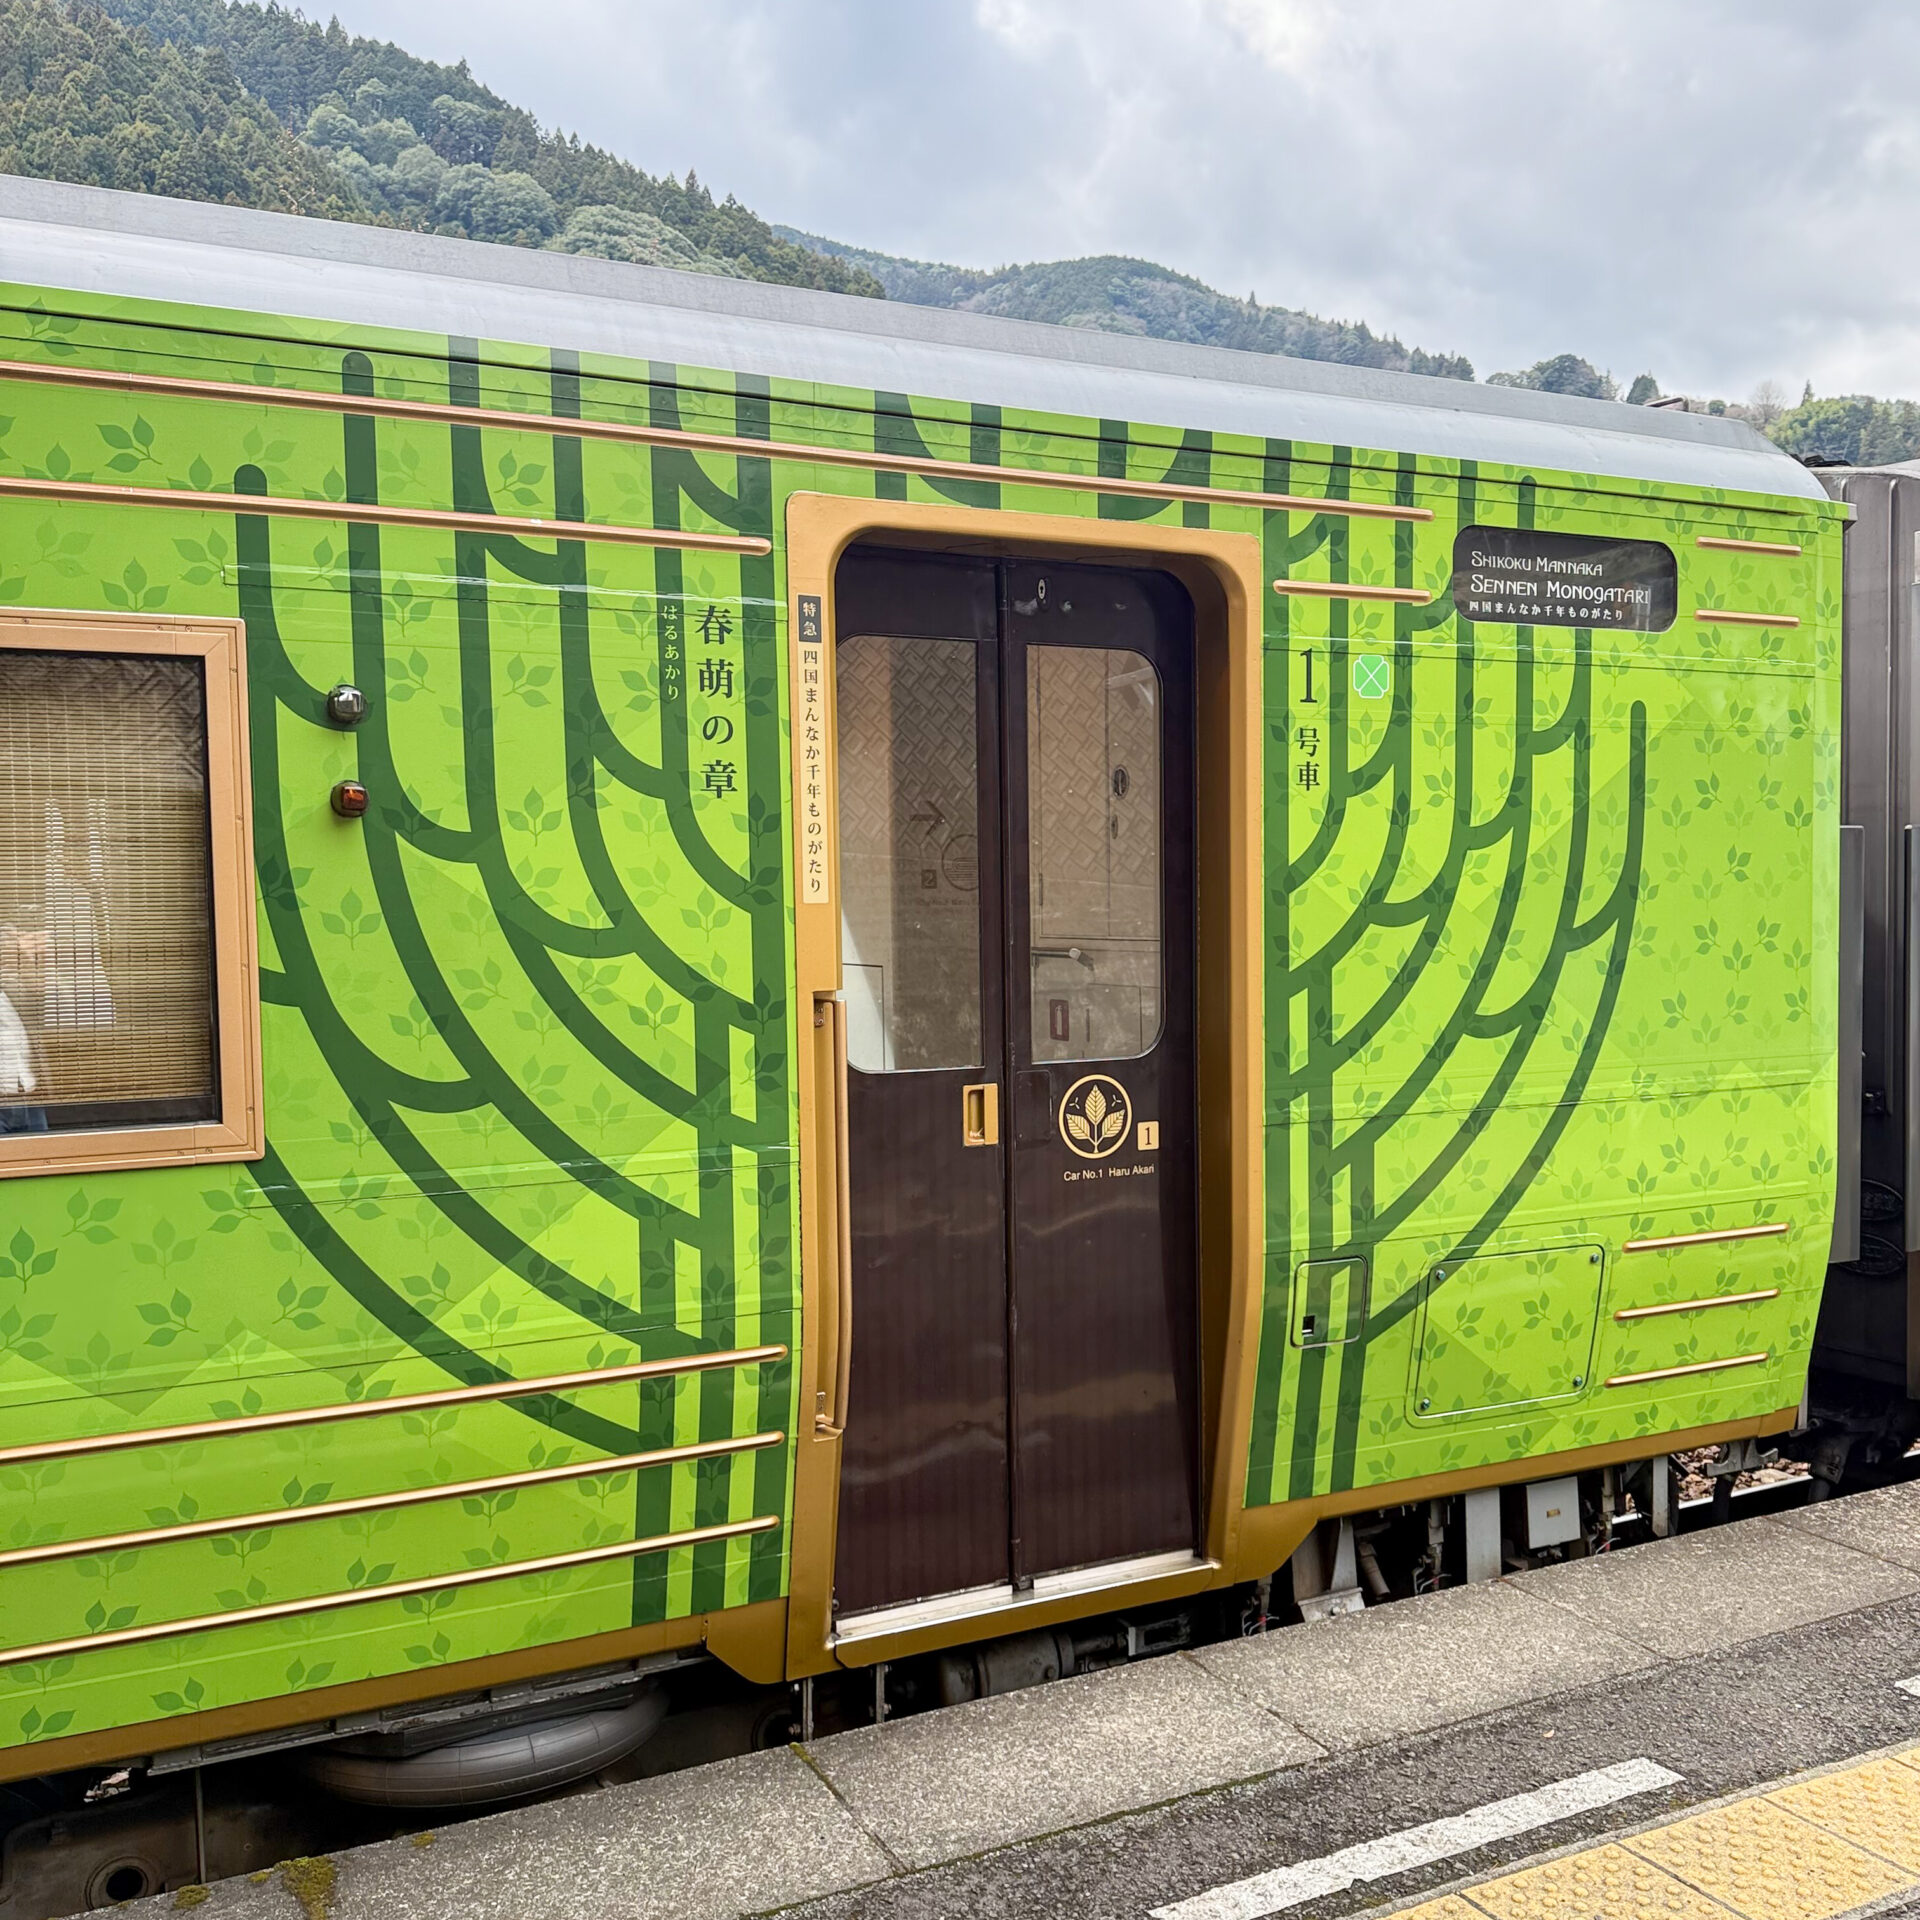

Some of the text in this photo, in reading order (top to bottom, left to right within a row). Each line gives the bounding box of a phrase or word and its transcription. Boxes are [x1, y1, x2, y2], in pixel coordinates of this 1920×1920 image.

[1471, 550, 1603, 577] SHIKOKU MANNAKA
[1470, 574, 1538, 597] SENNEN
[802, 601, 818, 636] 特急
[1469, 601, 1624, 621] 四国まんなか千年ものがたり
[661, 604, 681, 700] はるあかり
[695, 604, 738, 799] 春萌の章
[803, 650, 823, 893] 四国まんなか千年ものがたり
[1144, 1126, 1151, 1145] 1
[1063, 1164, 1154, 1181] Car No.1 Haru Akari
